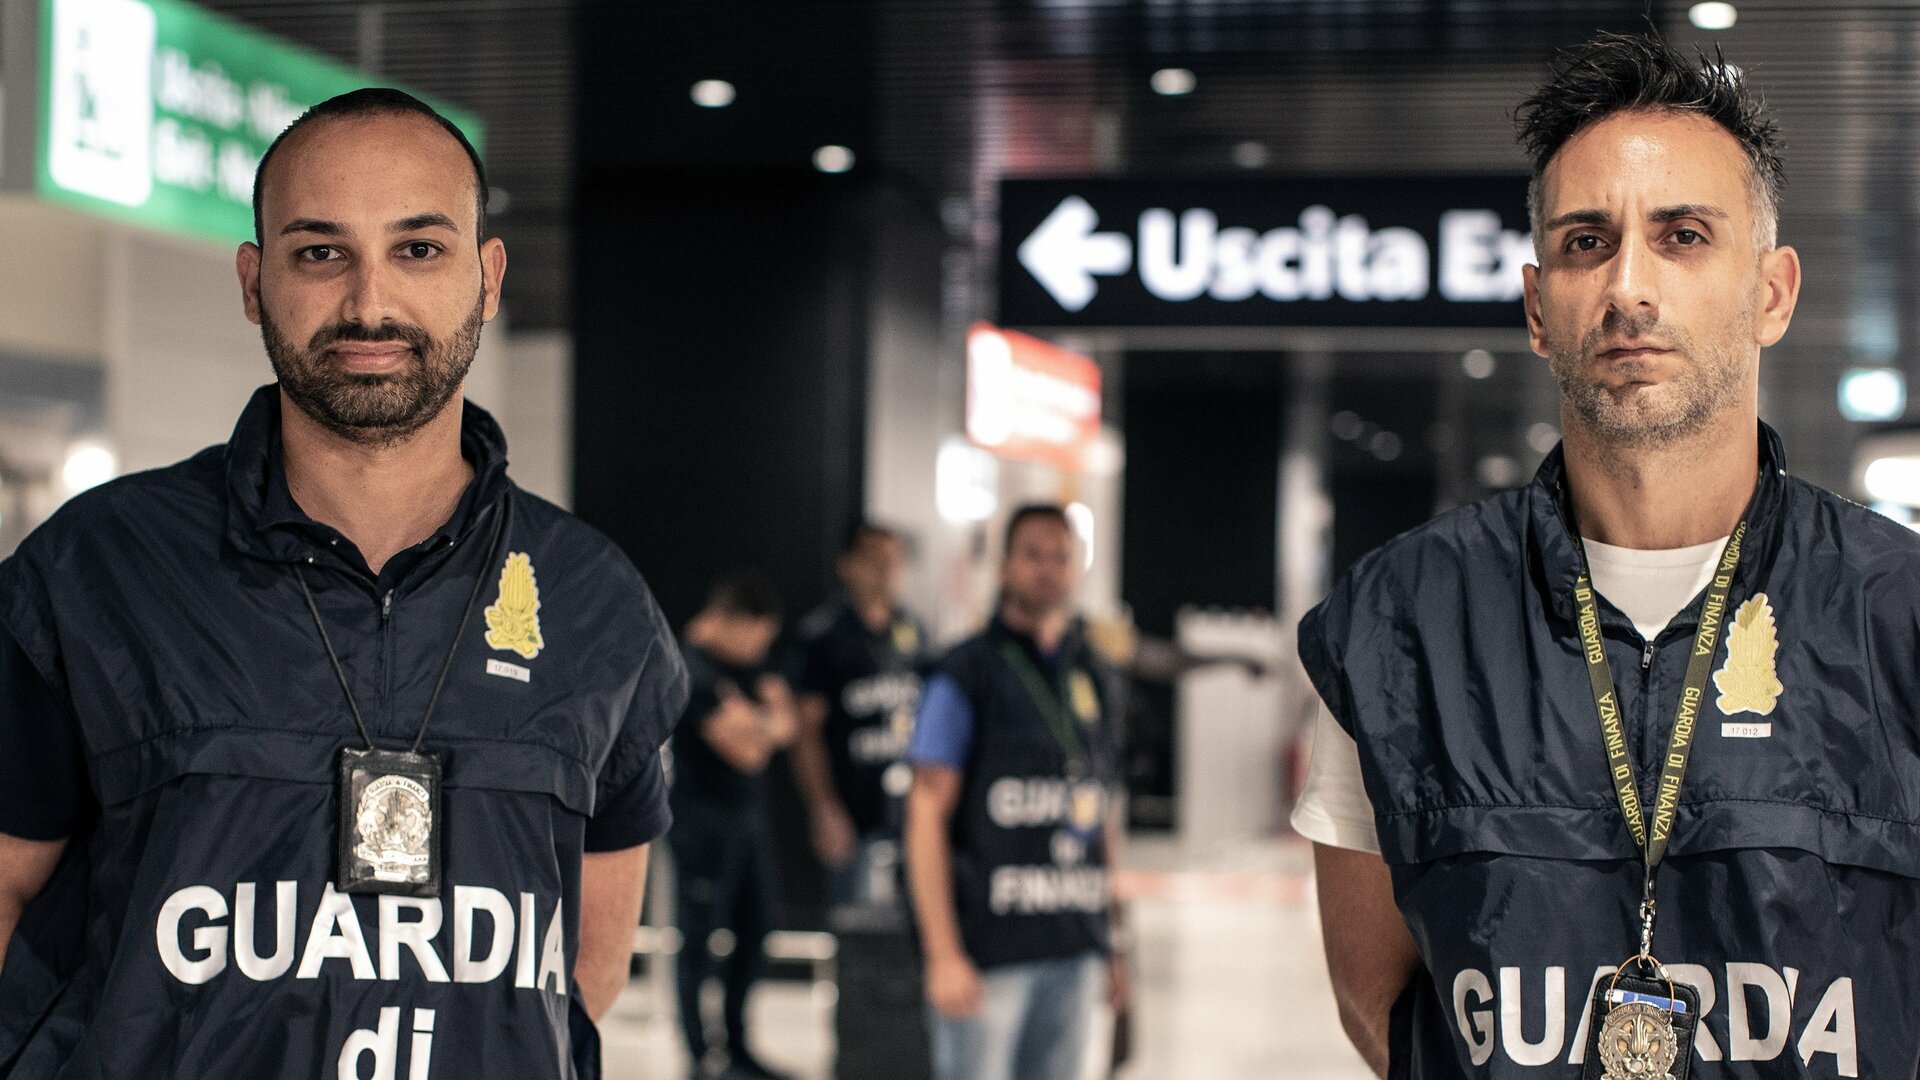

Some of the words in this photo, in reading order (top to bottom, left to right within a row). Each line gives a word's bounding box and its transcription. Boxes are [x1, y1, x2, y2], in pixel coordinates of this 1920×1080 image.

[1137, 204, 1430, 301] Uscita
[1720, 521, 1746, 571] GUARDIA
[1575, 588, 1592, 602] DI
[1714, 575, 1730, 588] DI
[1581, 604, 1604, 664] GUARDIA
[1695, 594, 1725, 656] FINANZA
[1598, 691, 1626, 759] FINANZA
[1672, 687, 1701, 748] GUARDIA
[1616, 762, 1631, 780] DI
[1667, 753, 1685, 768] DI
[1620, 781, 1646, 845] GUARDIA
[1653, 775, 1680, 841] FINANZA
[156, 880, 567, 996] GUARDIA
[337, 1006, 436, 1080] di
